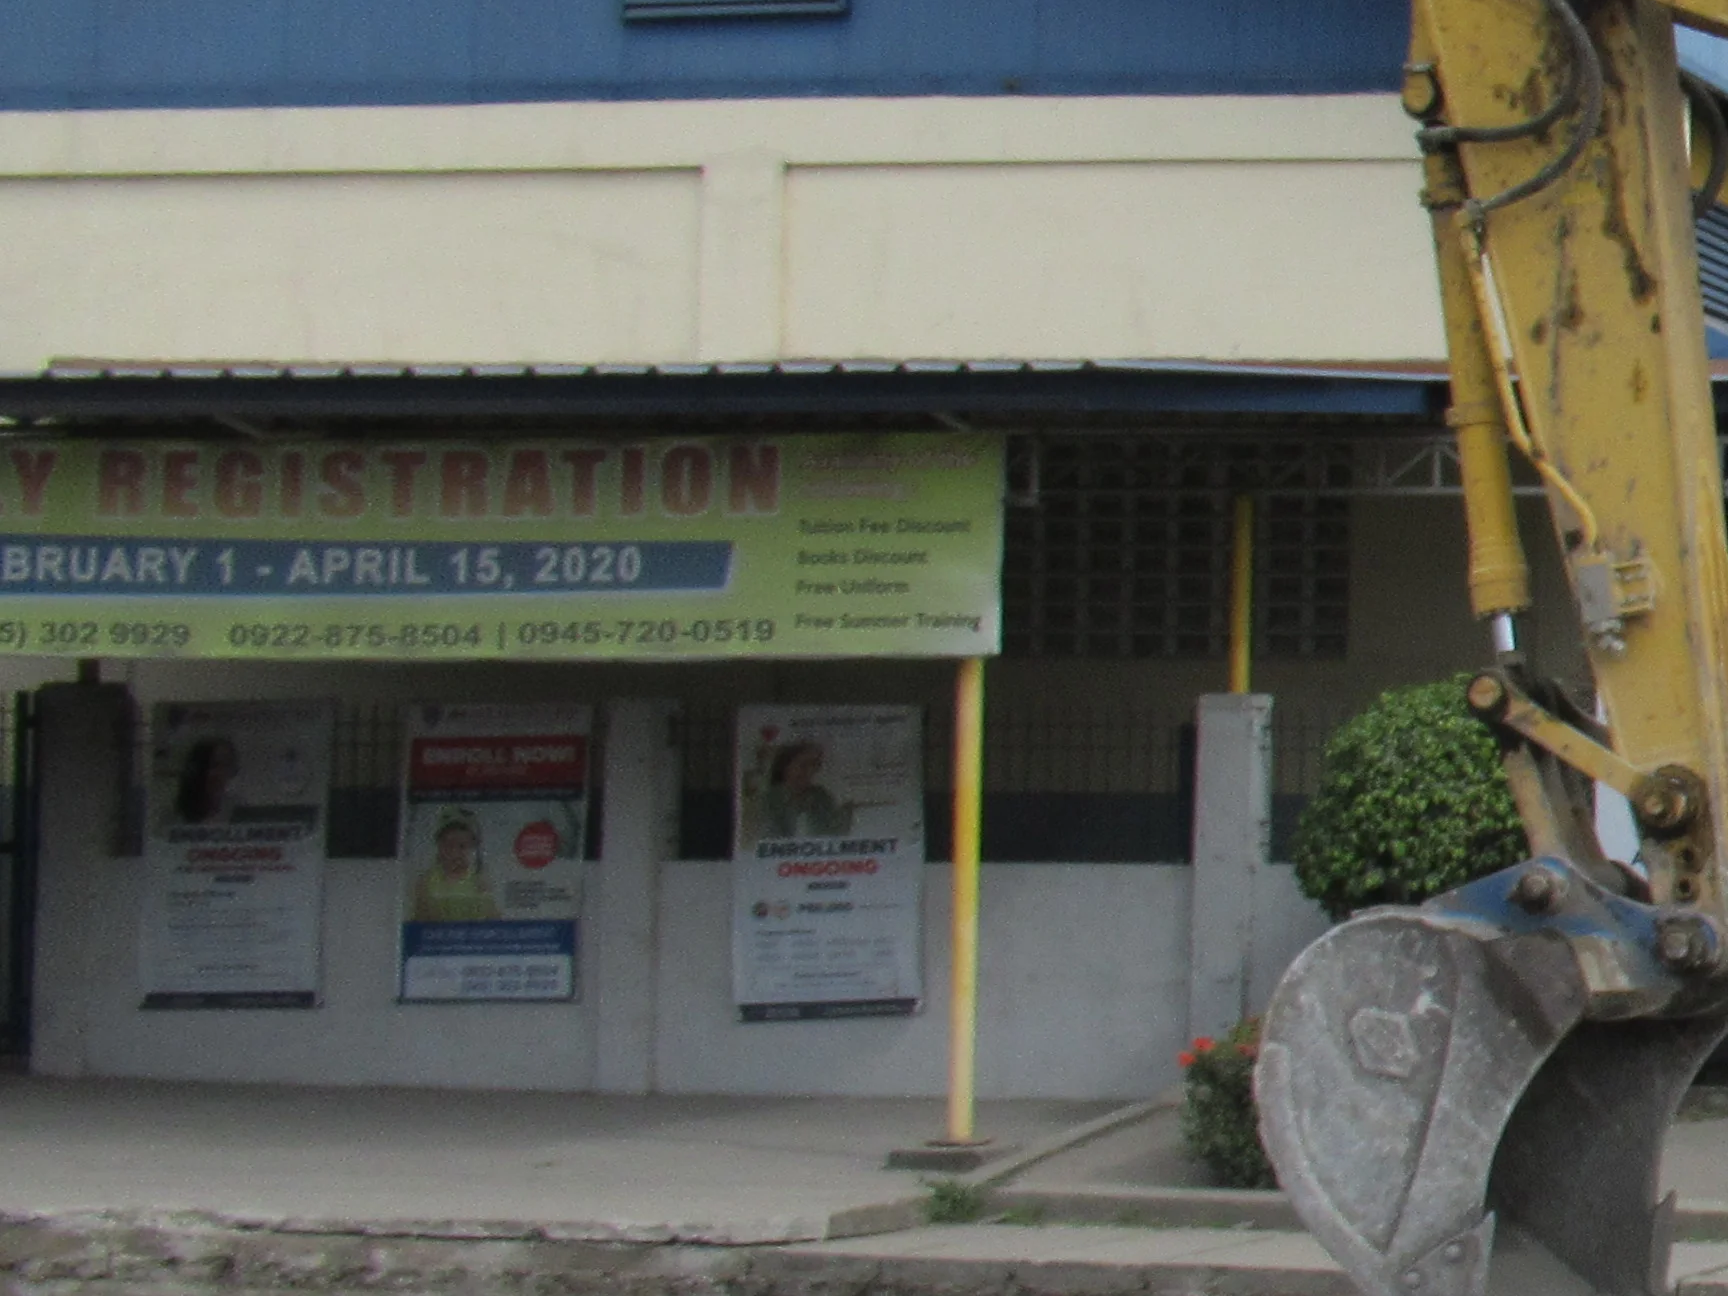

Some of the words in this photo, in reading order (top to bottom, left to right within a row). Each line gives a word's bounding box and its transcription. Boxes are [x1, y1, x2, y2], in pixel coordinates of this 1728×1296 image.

[98, 444, 781, 519] REGISTRATION
[0, 545, 198, 585] BRUARY
[215, 546, 235, 585] 1
[286, 546, 431, 586] APRIL
[450, 546, 514, 589] 15,
[533, 544, 643, 584] 2020
[40, 620, 99, 646] 302
[107, 621, 191, 647] 9929
[757, 837, 899, 859] ENROLLMENT
[777, 859, 880, 878] ONGOING
